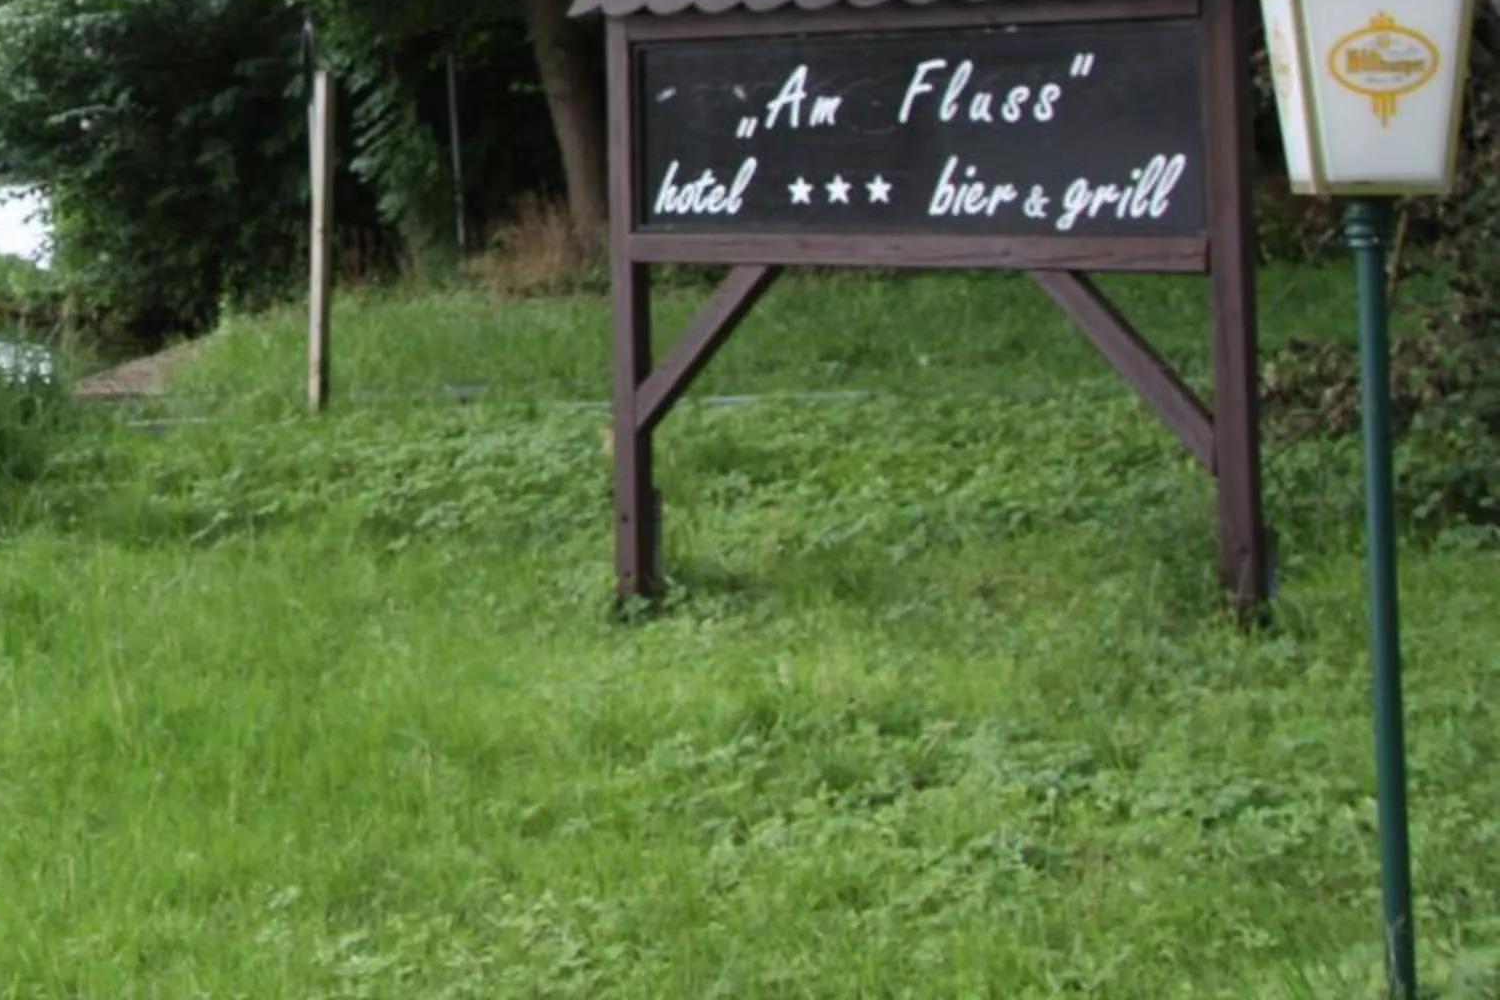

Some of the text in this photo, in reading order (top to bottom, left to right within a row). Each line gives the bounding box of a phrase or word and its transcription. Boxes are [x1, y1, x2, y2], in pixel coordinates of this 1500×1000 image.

[652, 152, 1188, 232] hotel bier & grill
